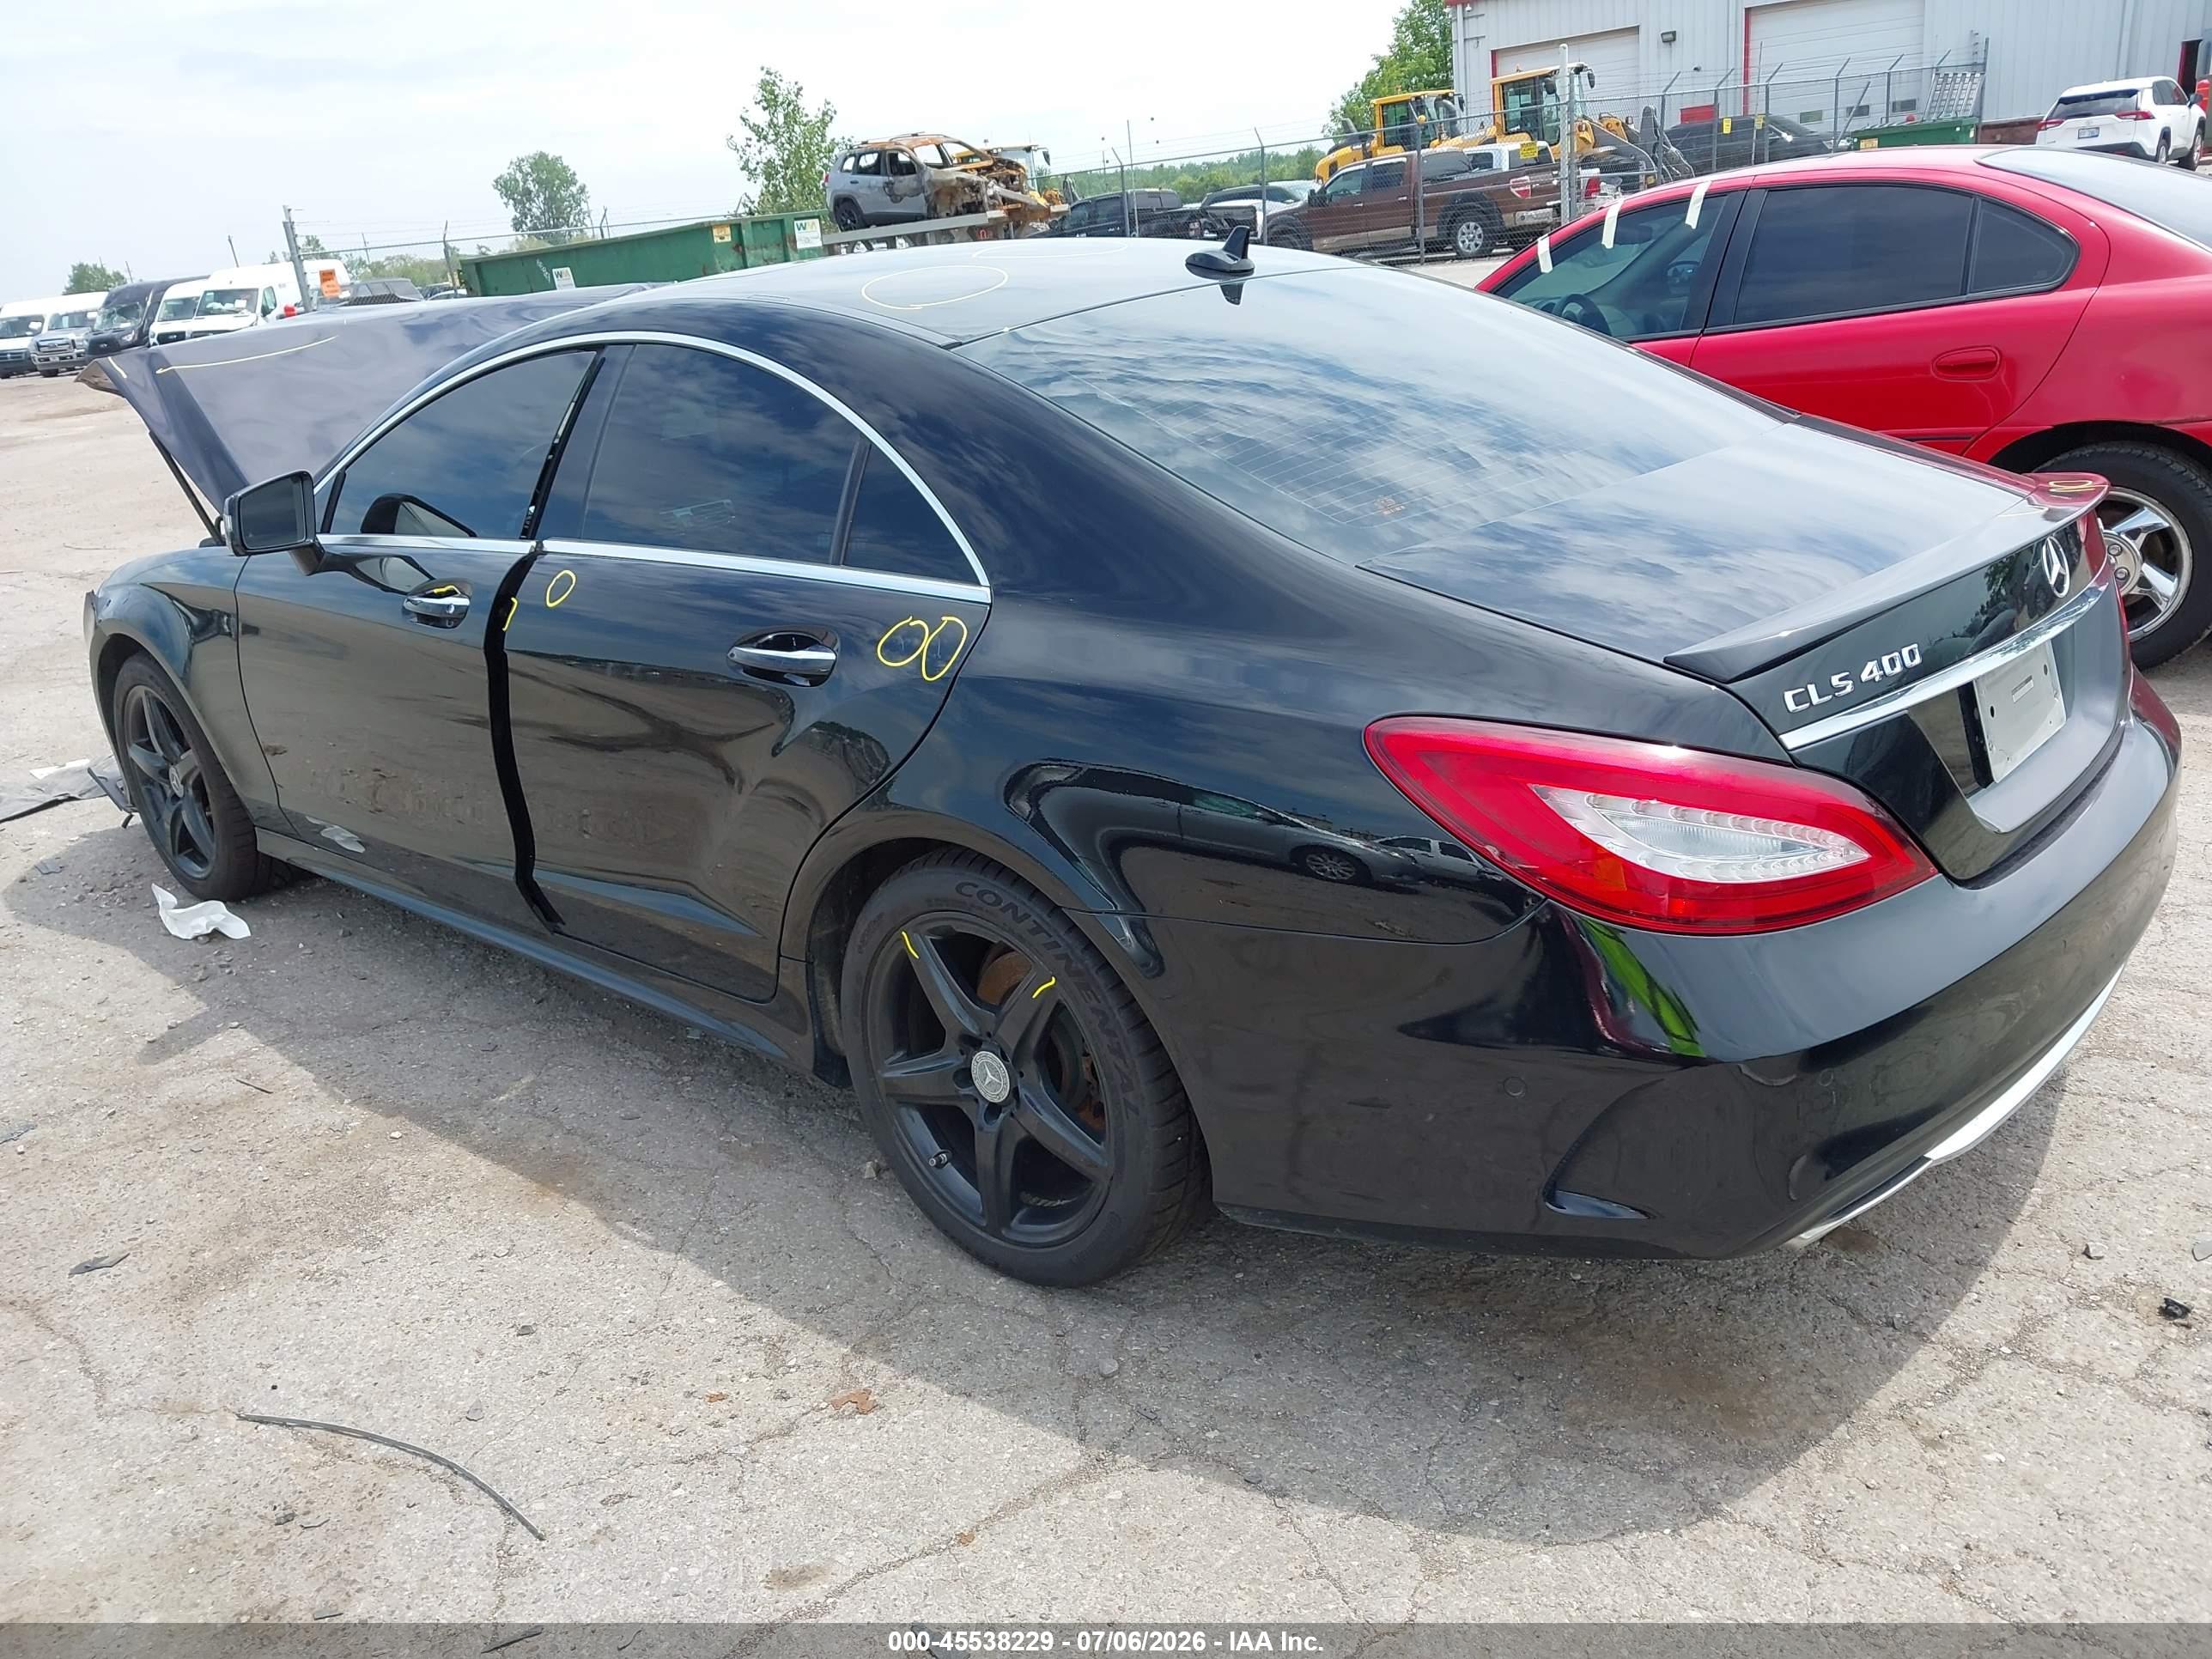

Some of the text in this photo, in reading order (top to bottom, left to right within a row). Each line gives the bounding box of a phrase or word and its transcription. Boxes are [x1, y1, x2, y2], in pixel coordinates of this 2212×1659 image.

[1784, 643, 1923, 714] CLS 400
[954, 881, 1140, 1120] CONTINENTAL
